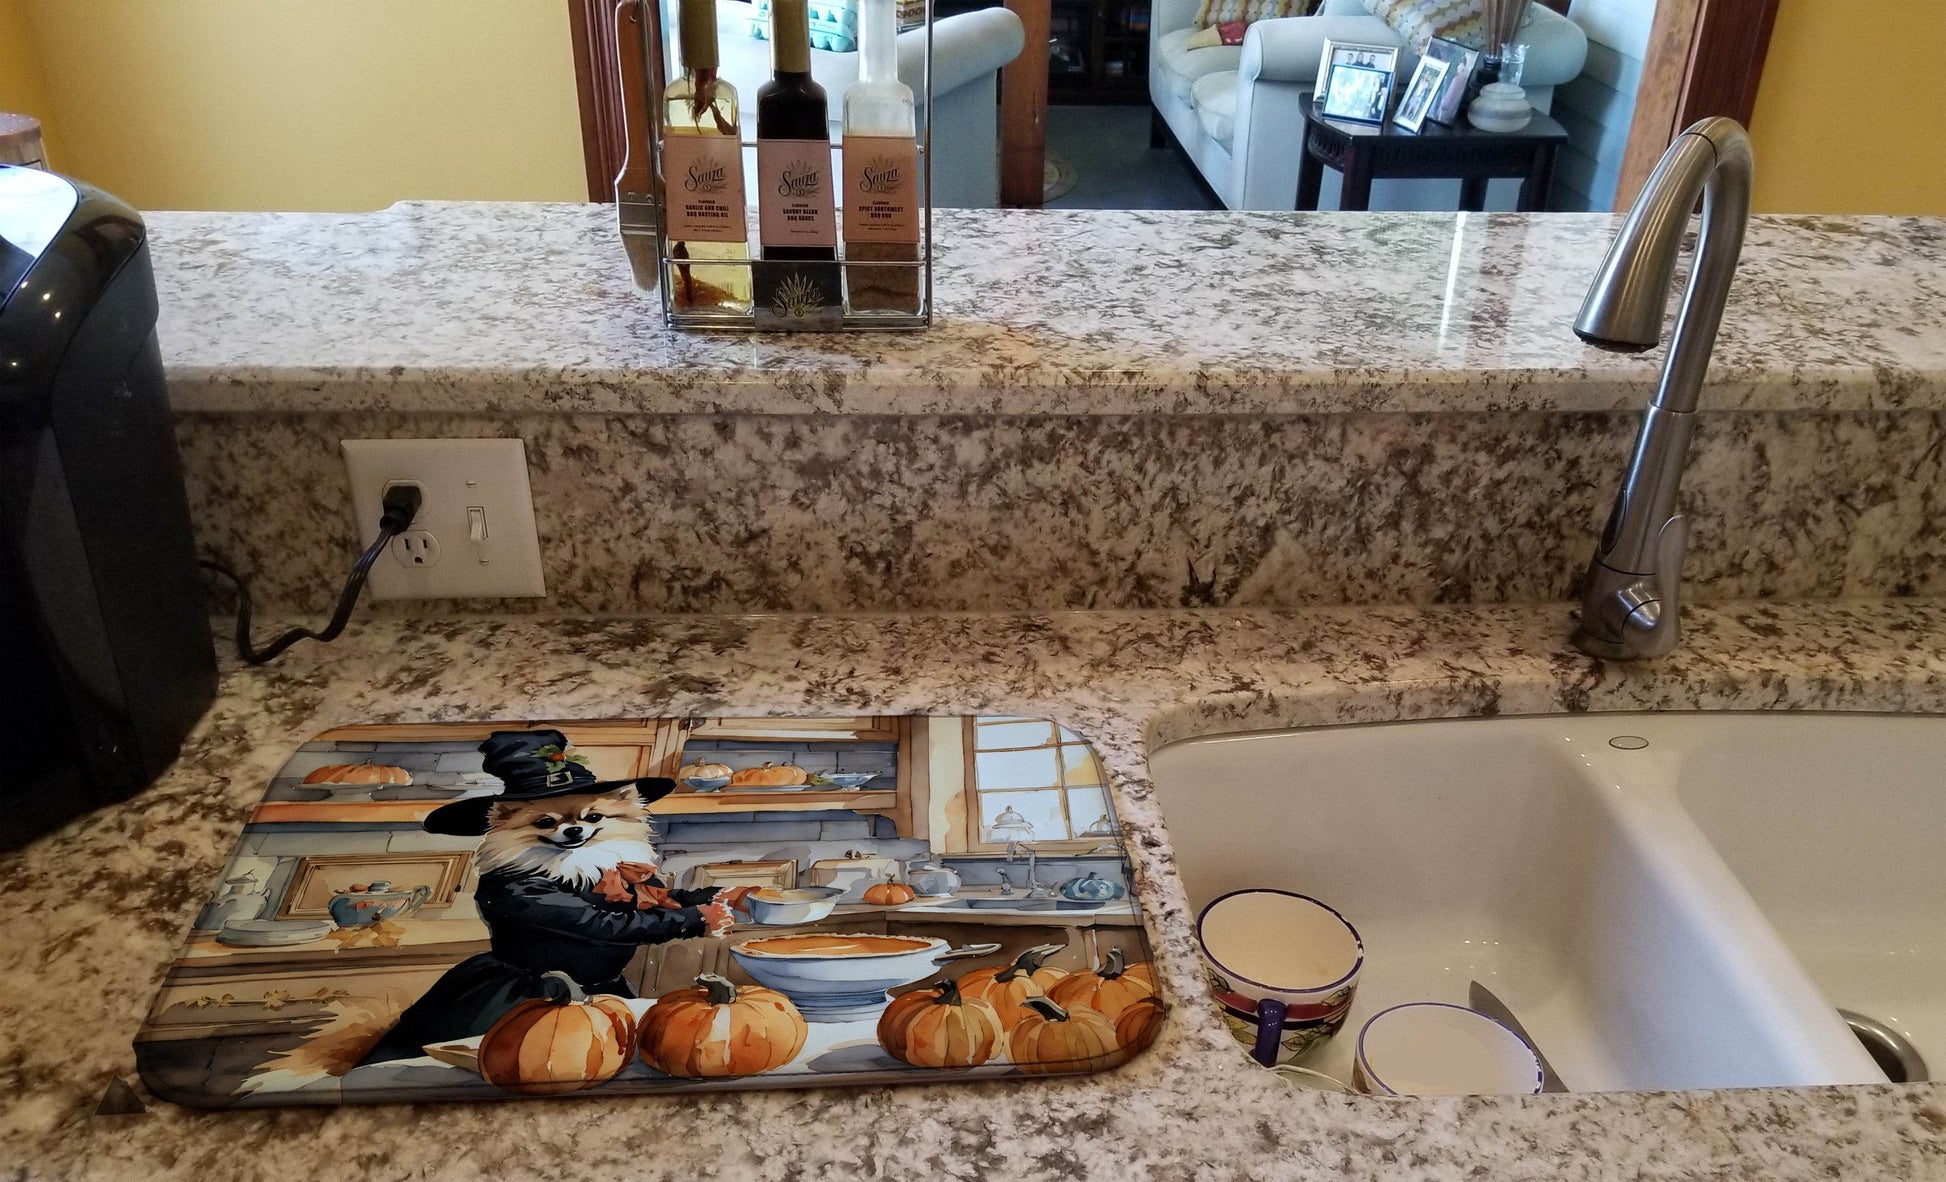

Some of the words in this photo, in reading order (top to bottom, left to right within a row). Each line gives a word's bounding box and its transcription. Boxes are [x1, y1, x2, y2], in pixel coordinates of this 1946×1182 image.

[684, 165, 726, 192] Sauza
[778, 170, 820, 197] Sauza
[859, 166, 901, 193] Sauza
